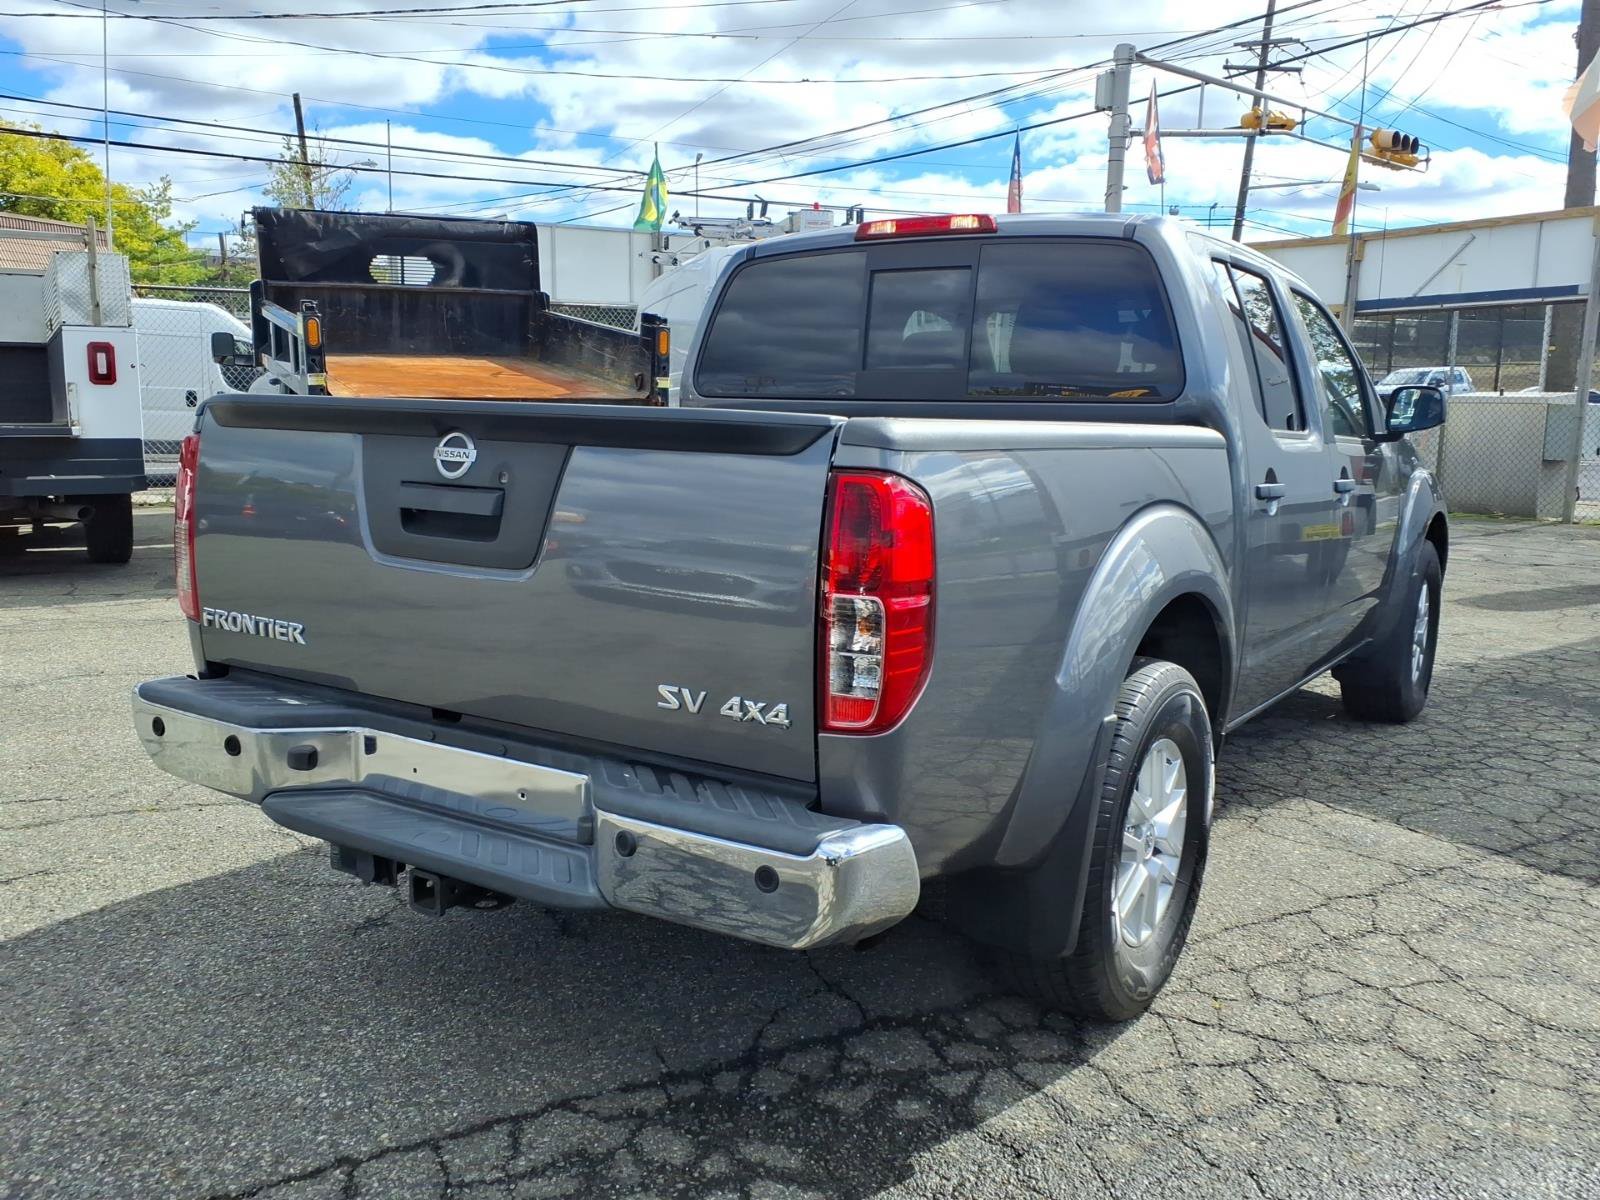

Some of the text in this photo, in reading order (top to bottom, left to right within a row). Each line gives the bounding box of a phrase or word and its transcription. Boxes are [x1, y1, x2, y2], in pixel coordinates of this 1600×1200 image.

[437, 448, 471, 460] NISSAN
[202, 606, 307, 646] FRONTIER
[657, 684, 707, 714] SV
